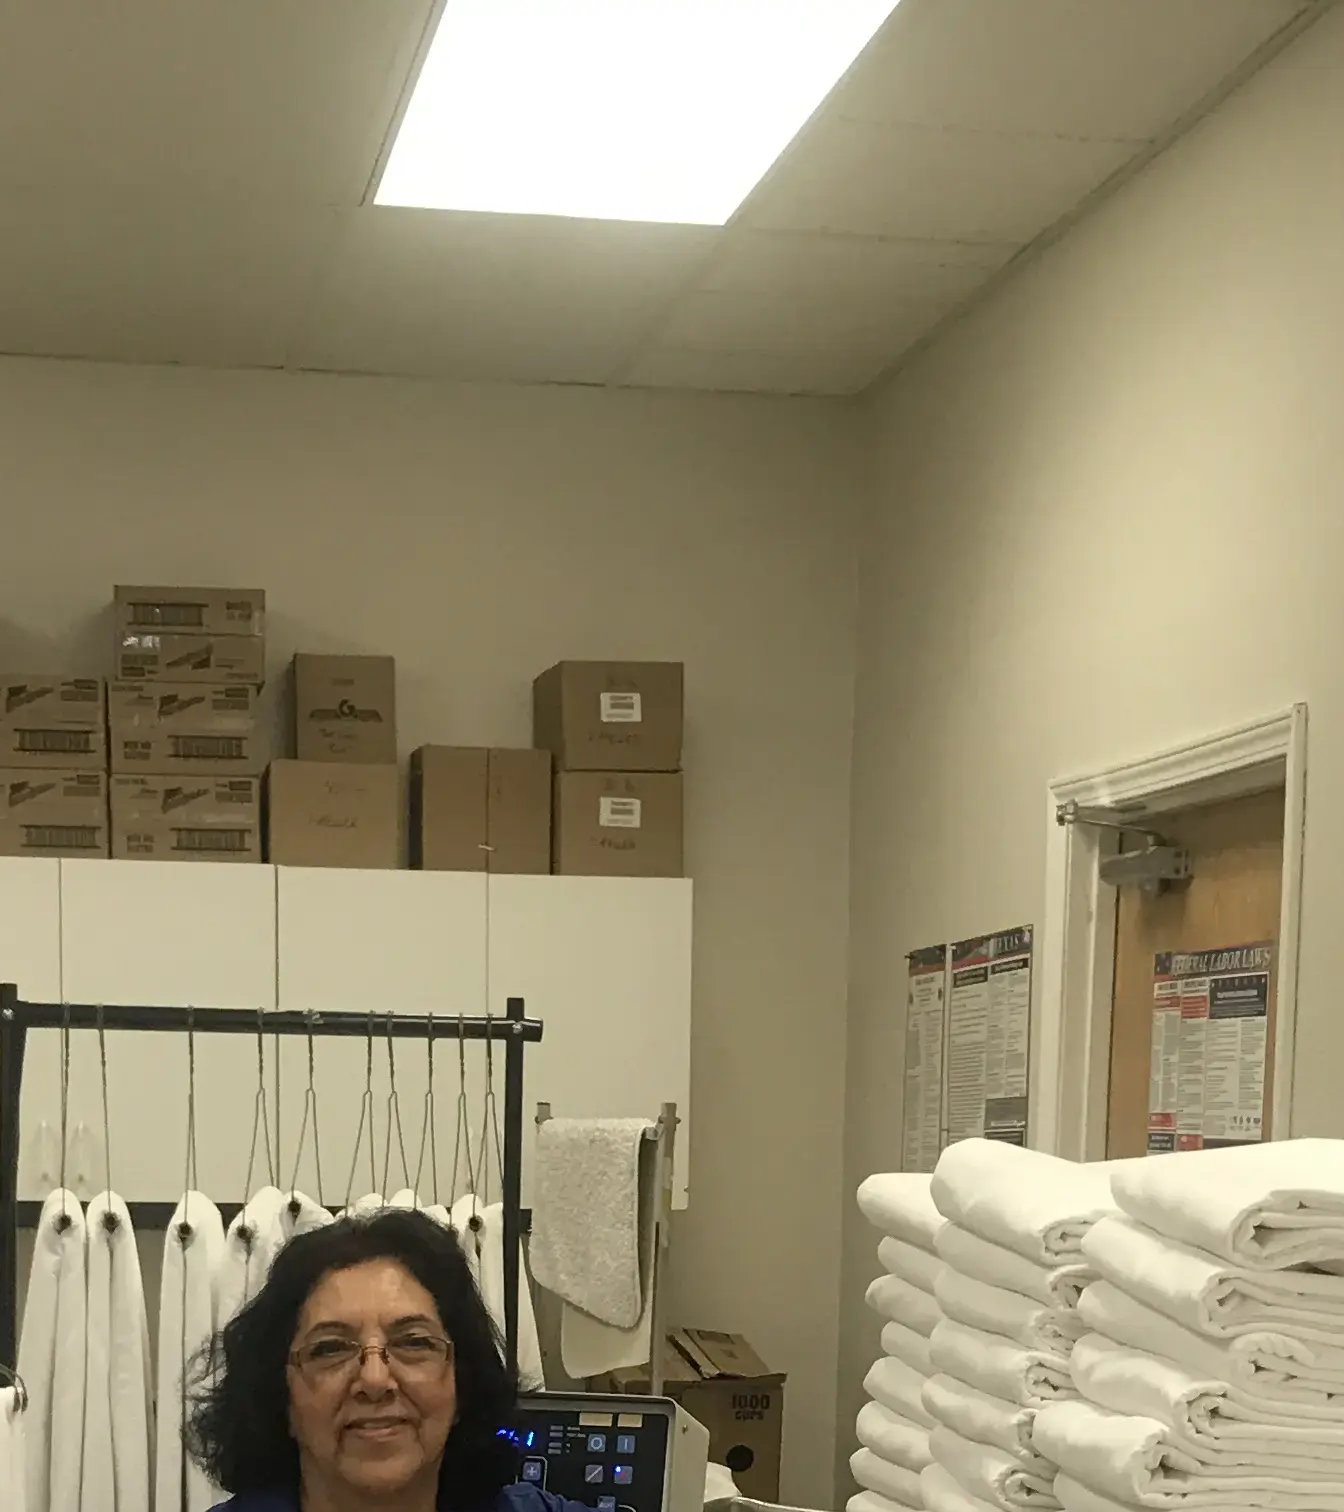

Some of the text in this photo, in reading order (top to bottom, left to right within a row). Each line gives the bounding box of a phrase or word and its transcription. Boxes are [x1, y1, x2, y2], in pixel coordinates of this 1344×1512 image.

[1209, 951, 1241, 972] LABOR
[1243, 948, 1272, 970] LAWS
[732, 1394, 770, 1410] 1000
